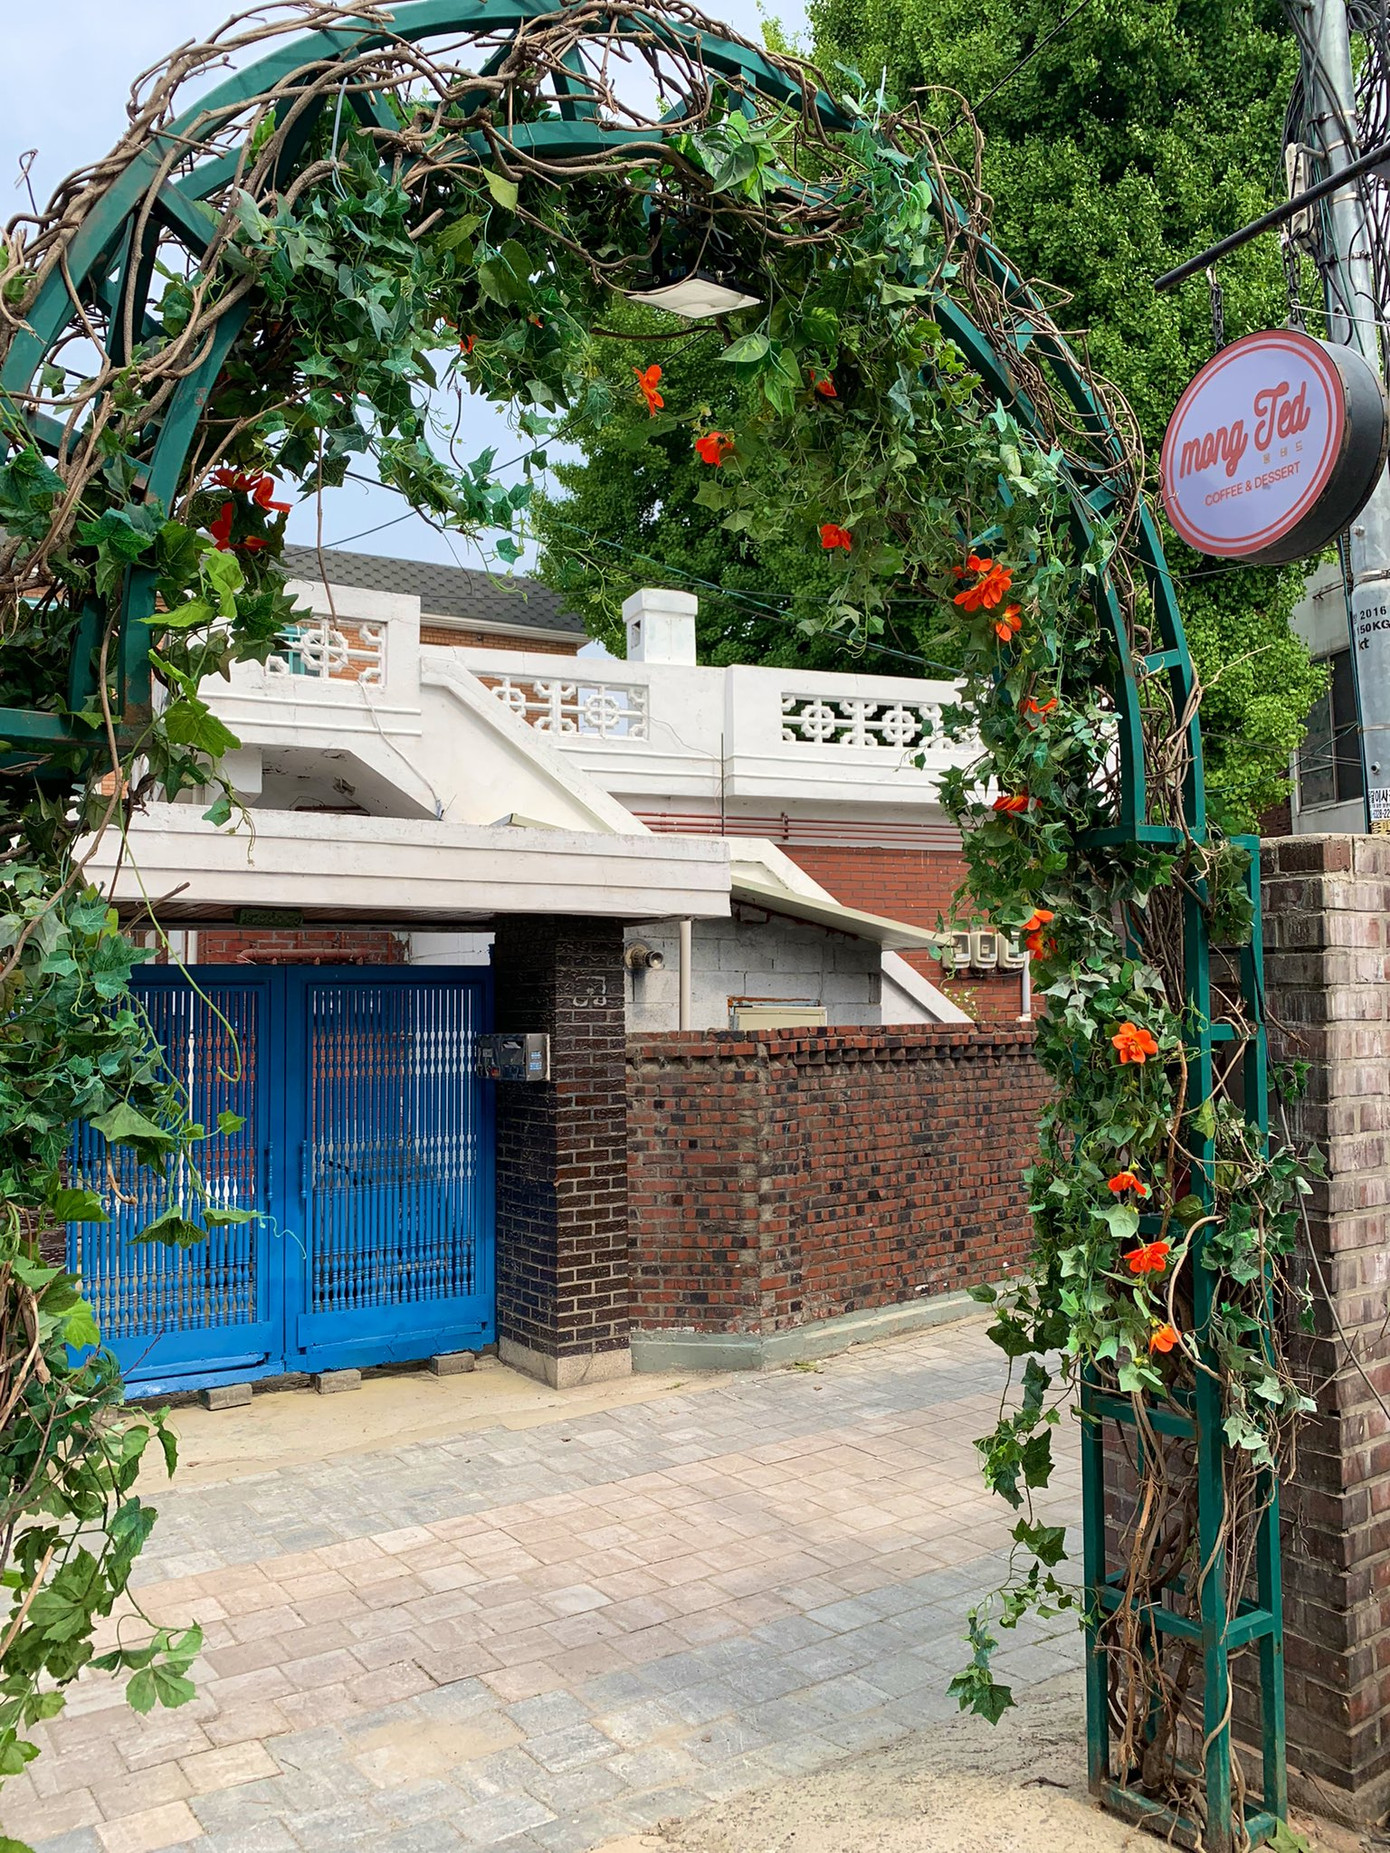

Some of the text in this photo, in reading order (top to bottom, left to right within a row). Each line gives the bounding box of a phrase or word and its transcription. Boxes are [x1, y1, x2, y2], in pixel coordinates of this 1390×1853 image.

[1254, 381, 1311, 451] Ted
[1205, 461, 1300, 506] COFFEE & DESSERT
[1360, 605, 1387, 620] 2016
